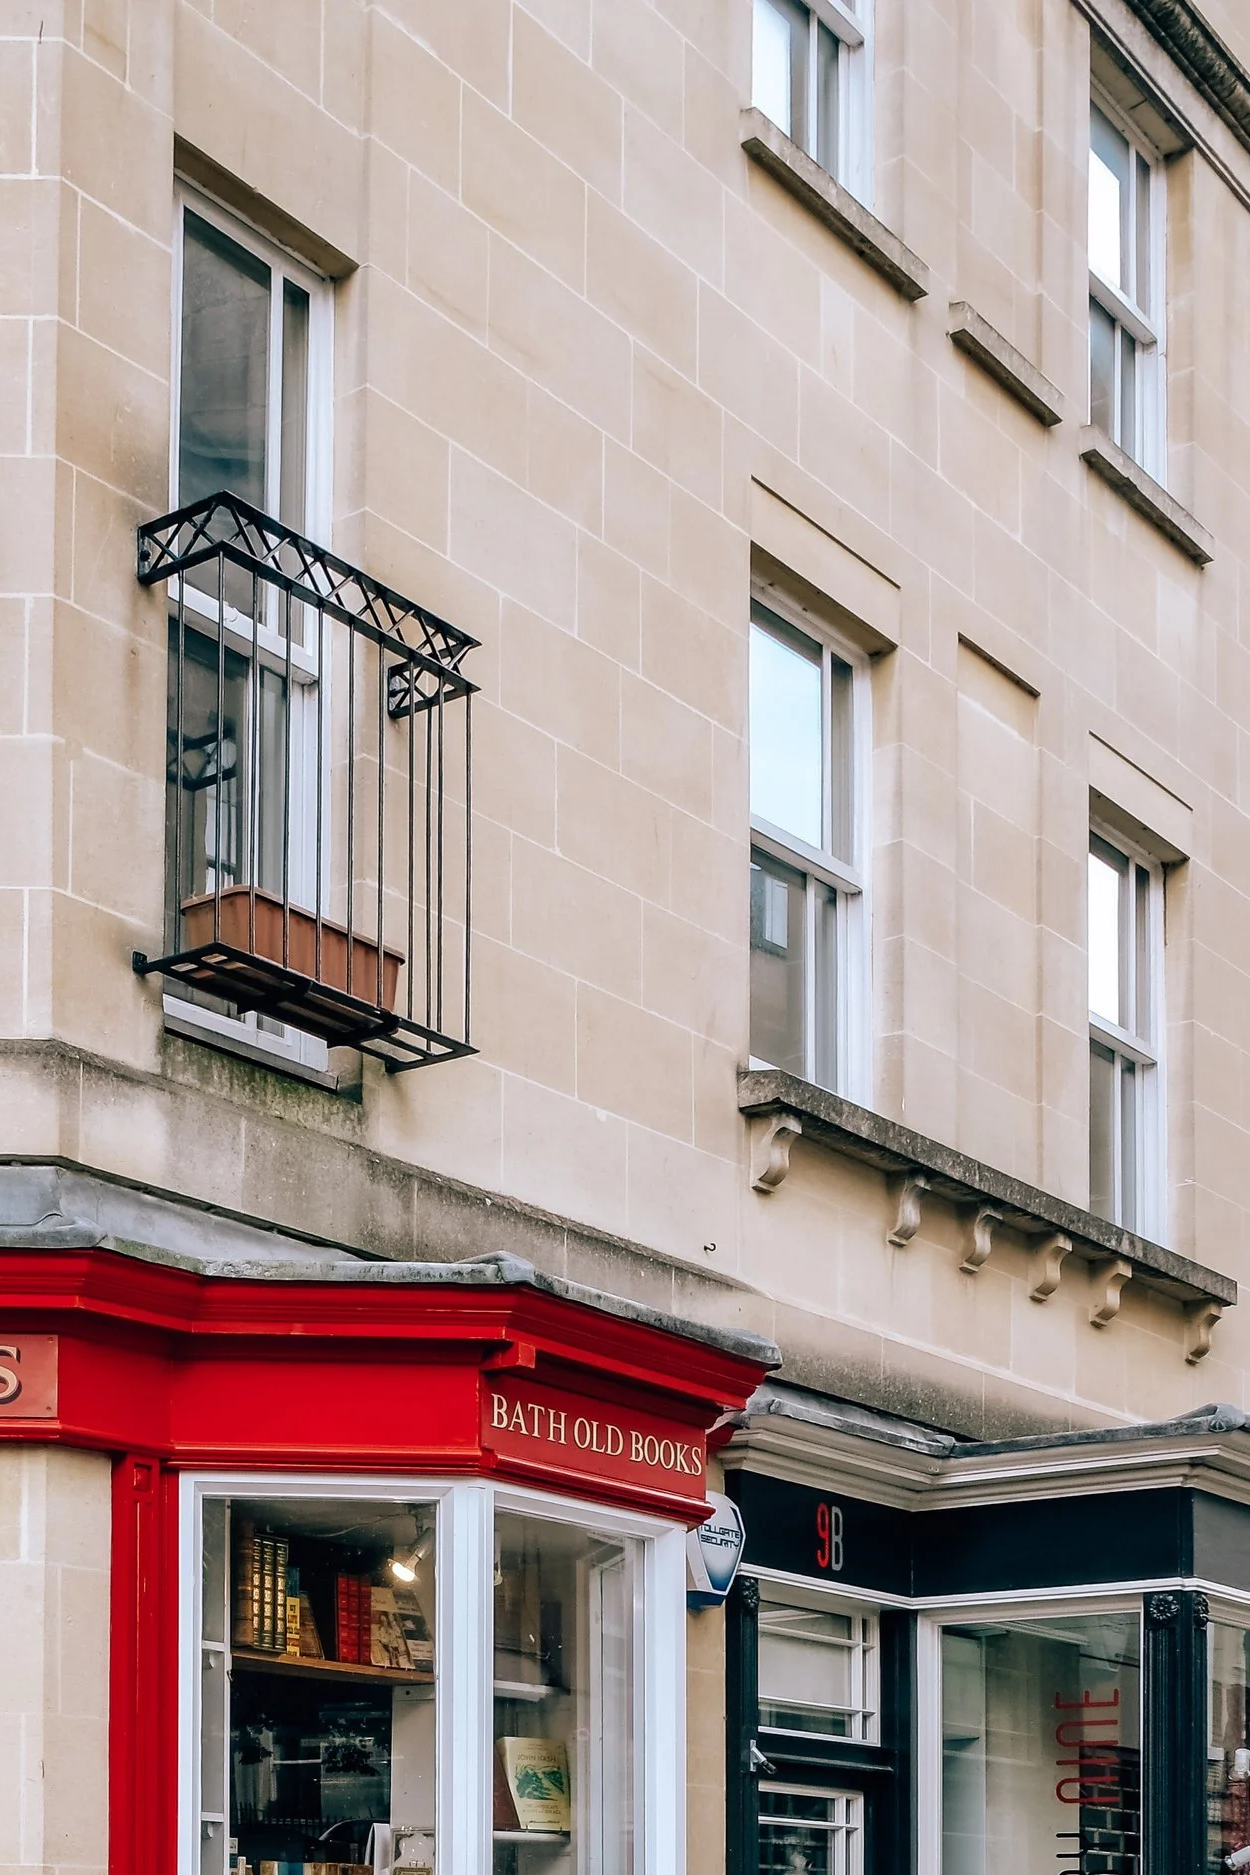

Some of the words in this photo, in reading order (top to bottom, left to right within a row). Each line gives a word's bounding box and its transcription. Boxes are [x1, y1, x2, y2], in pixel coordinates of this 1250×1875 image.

[491, 1393, 568, 1445] BATH
[573, 1417, 624, 1456] OLD
[630, 1430, 703, 1476] BOOKS
[700, 1534, 740, 1550] SECURITY
[816, 1502, 844, 1572] 9B
[1056, 1689, 1120, 1804] NINE
